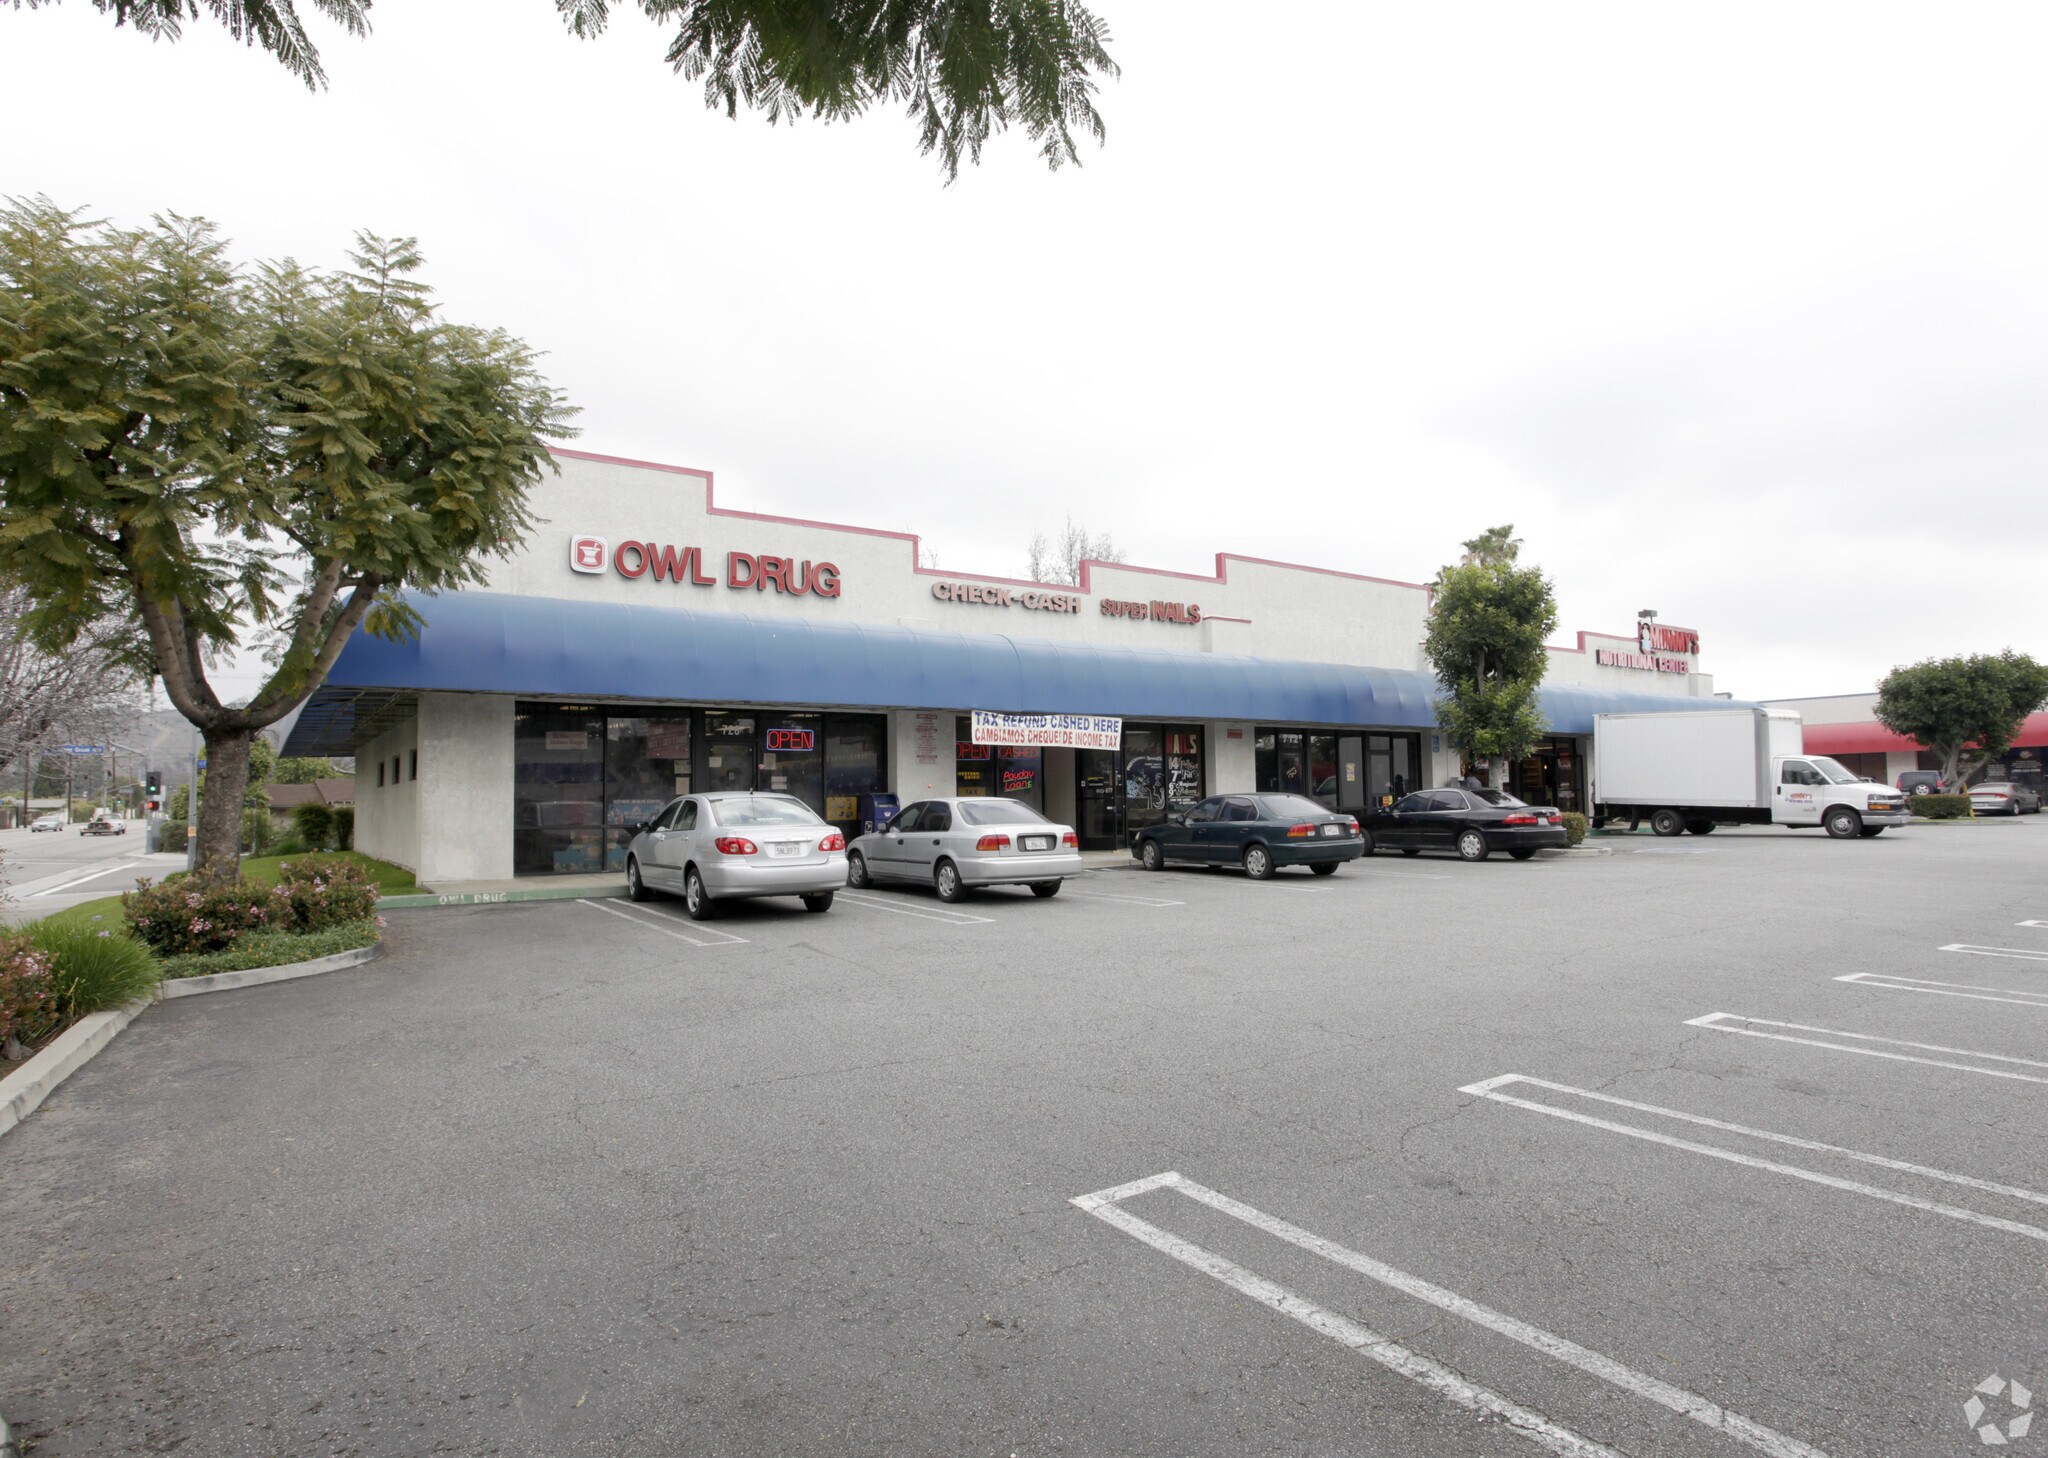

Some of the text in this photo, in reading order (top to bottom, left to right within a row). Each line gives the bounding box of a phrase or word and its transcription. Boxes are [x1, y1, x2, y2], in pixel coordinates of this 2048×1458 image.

[613, 540, 841, 598] OWL DRUG
[932, 581, 1081, 613] CHECK-CASH
[1101, 598, 1201, 624] SUPER NAILS
[1597, 649, 1689, 674] NUTRITIONAL CENTER
[975, 711, 1119, 733] TAX REFUND CASHED HERE
[768, 730, 812, 749] OPEN
[975, 728, 1025, 743] CAMBIAMOS
[1062, 730, 1073, 745] DE
[1075, 731, 1103, 747] INCOME
[1105, 734, 1118, 748] TAX
[1003, 769, 1034, 781] Payday
